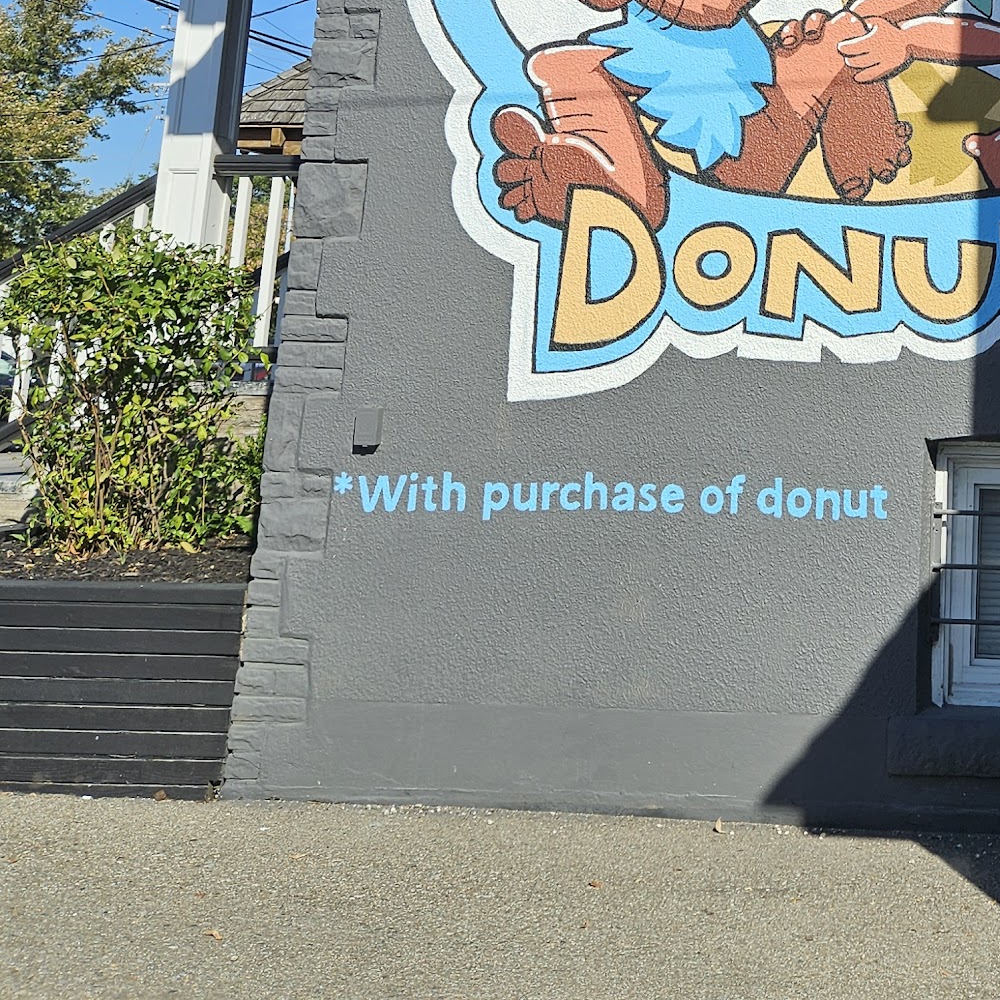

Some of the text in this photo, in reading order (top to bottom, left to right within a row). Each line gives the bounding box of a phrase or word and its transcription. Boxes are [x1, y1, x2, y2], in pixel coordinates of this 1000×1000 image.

[482, 472, 685, 521] purchase
[700, 474, 747, 515] of
[757, 477, 889, 521] donut
